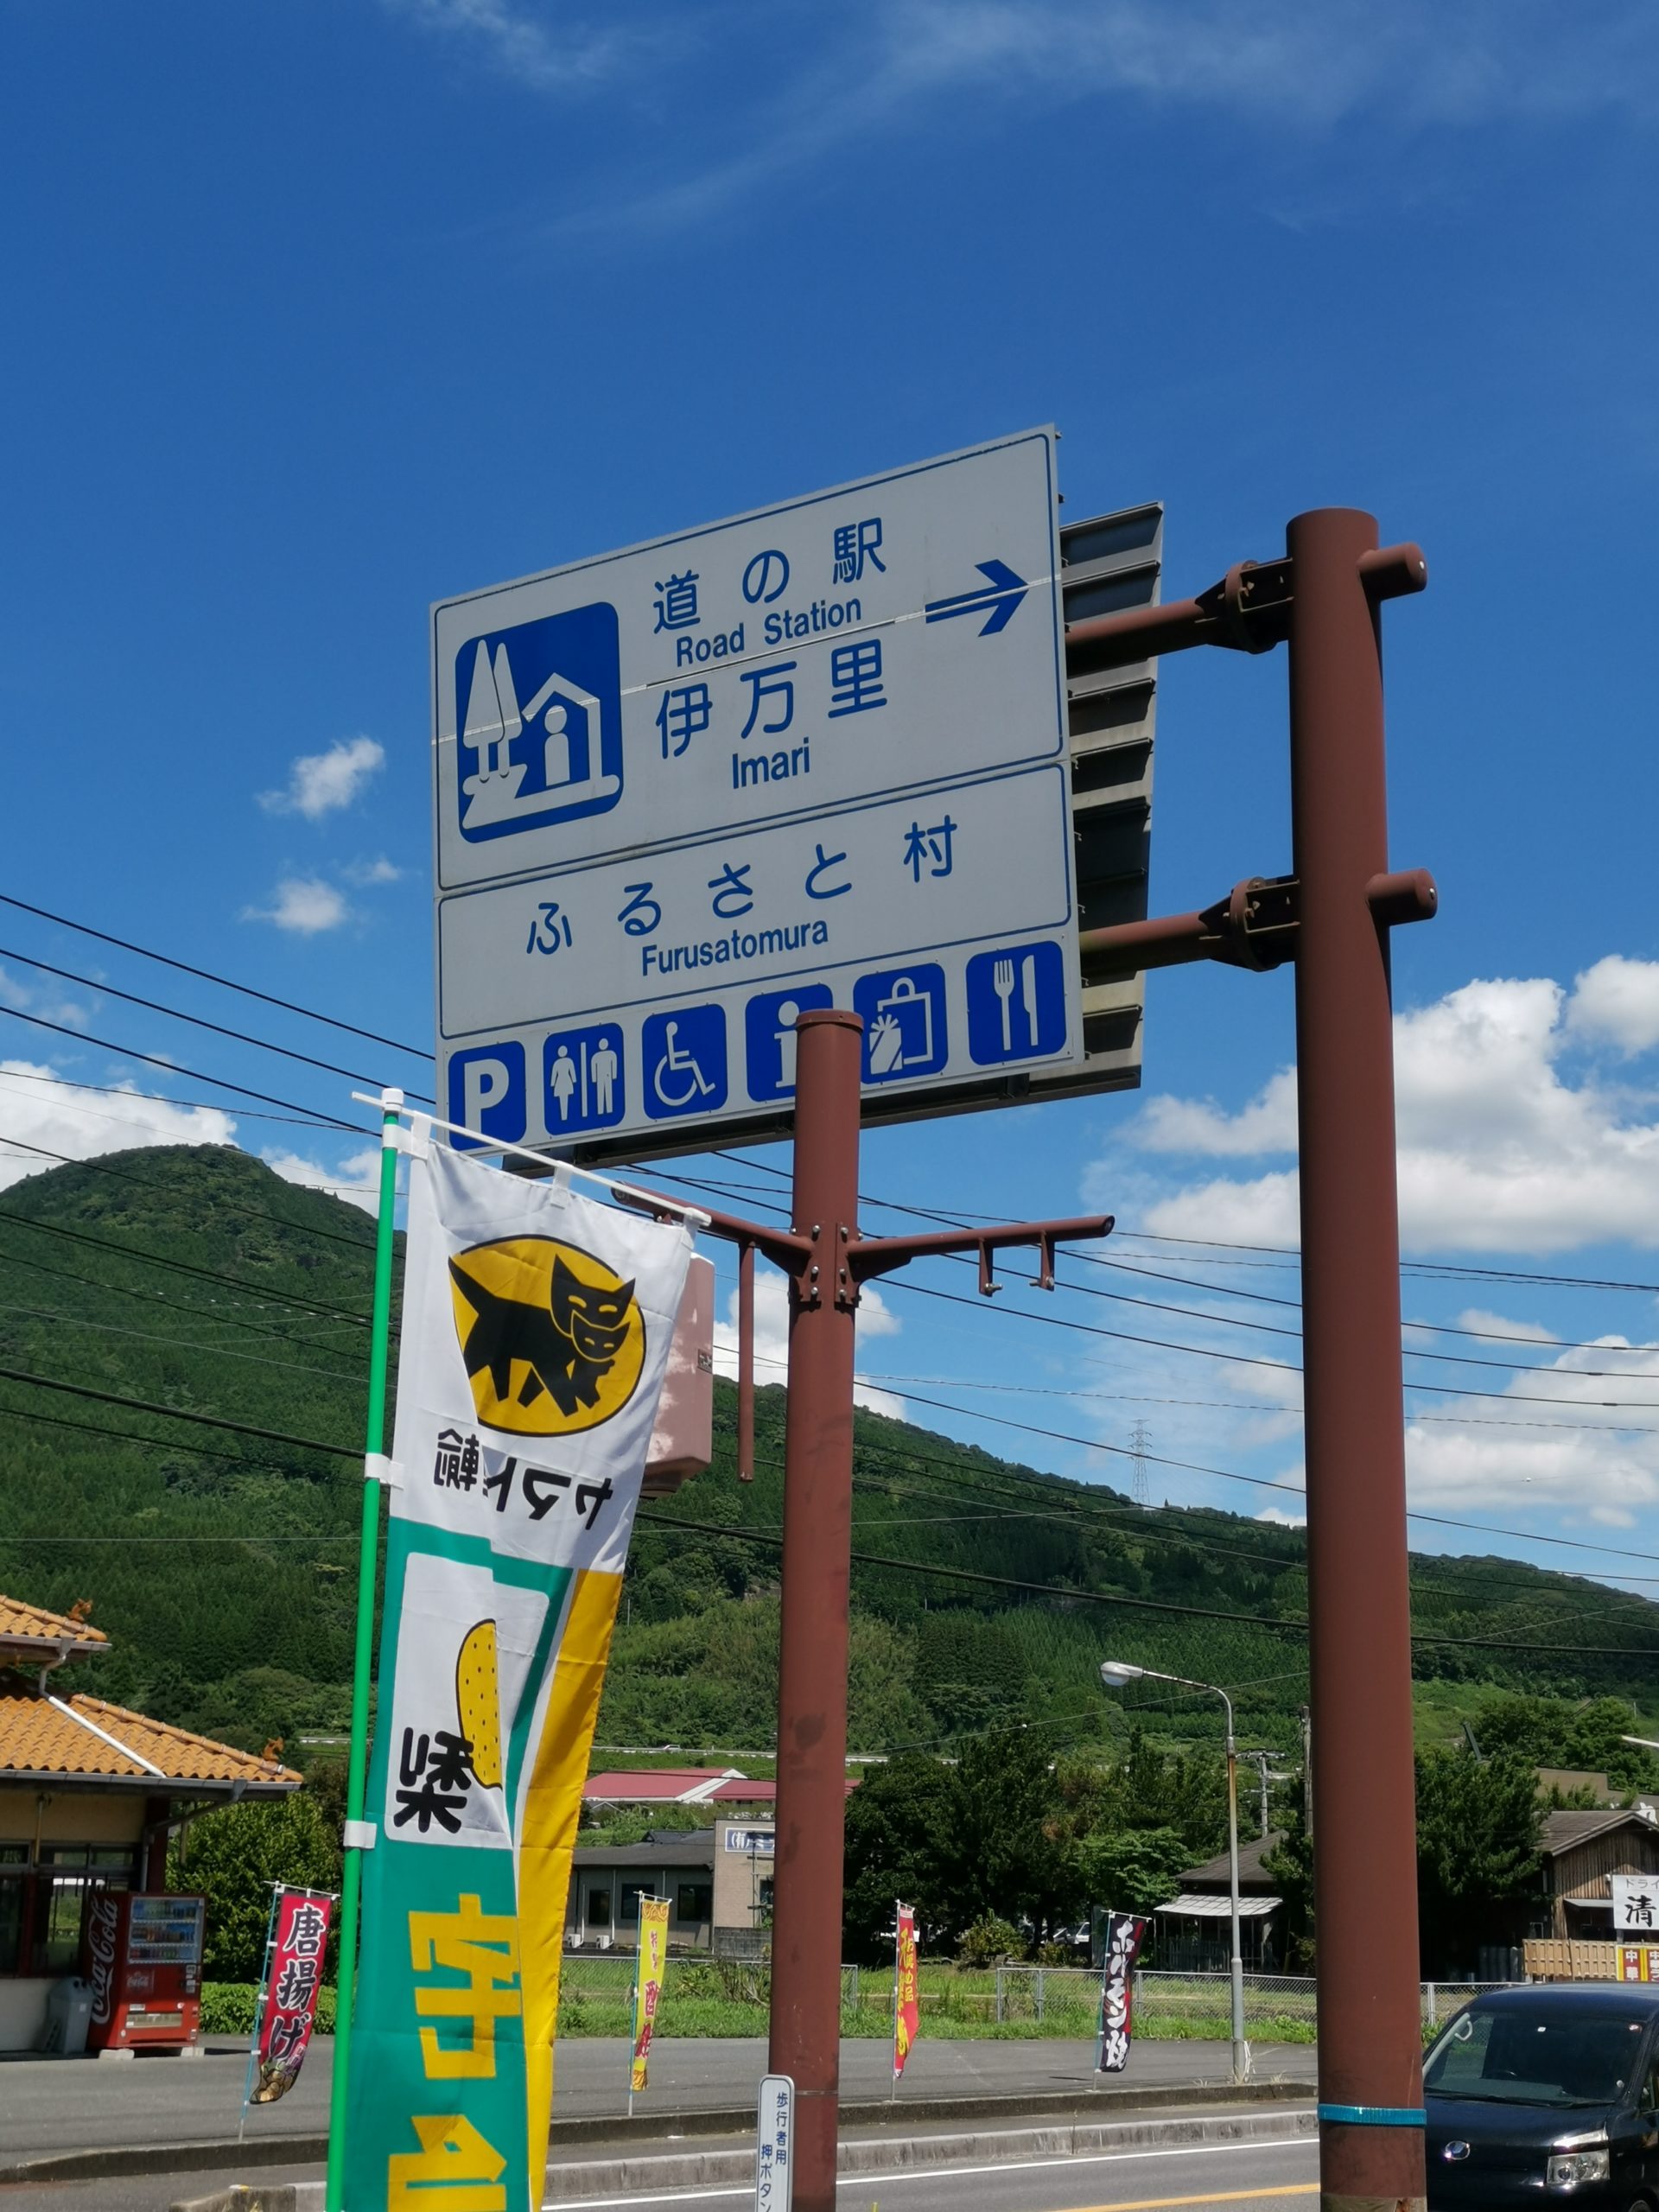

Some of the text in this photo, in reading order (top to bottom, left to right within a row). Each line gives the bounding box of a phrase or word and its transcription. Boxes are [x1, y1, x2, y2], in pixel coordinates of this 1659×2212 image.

[653, 517, 887, 634] 道の駅
[677, 598, 861, 667] Road Station
[655, 639, 887, 760] 伊万里
[733, 736, 810, 790] Imari
[526, 815, 957, 955] ふるさと村
[641, 920, 829, 976] Furusatomura
[464, 1058, 510, 1137] P
[268, 1903, 327, 2062] 唐揚げ
[775, 2091, 788, 2165] 歩行者用
